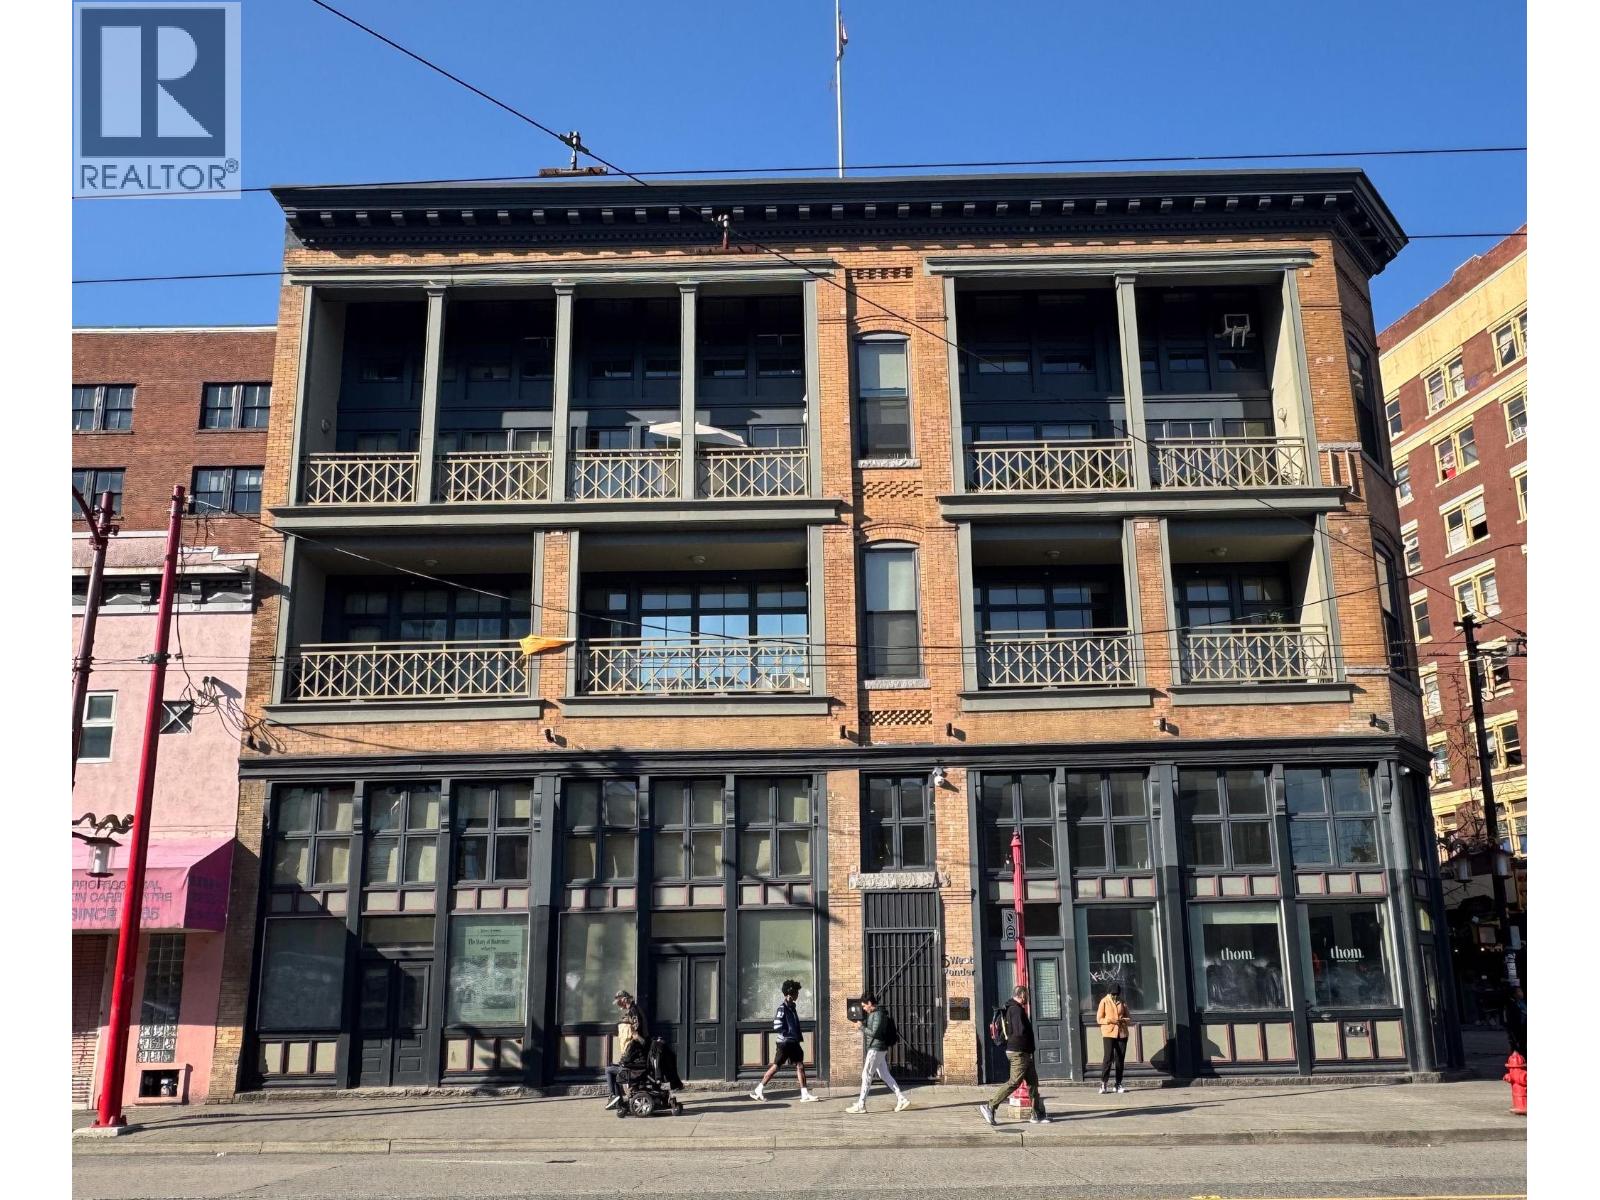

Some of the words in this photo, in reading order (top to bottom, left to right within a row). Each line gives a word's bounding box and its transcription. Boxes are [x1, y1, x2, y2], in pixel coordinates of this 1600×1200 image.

[1102, 950, 1137, 964] thom.
[1220, 947, 1256, 961] thom.
[1330, 945, 1365, 959] thom.
